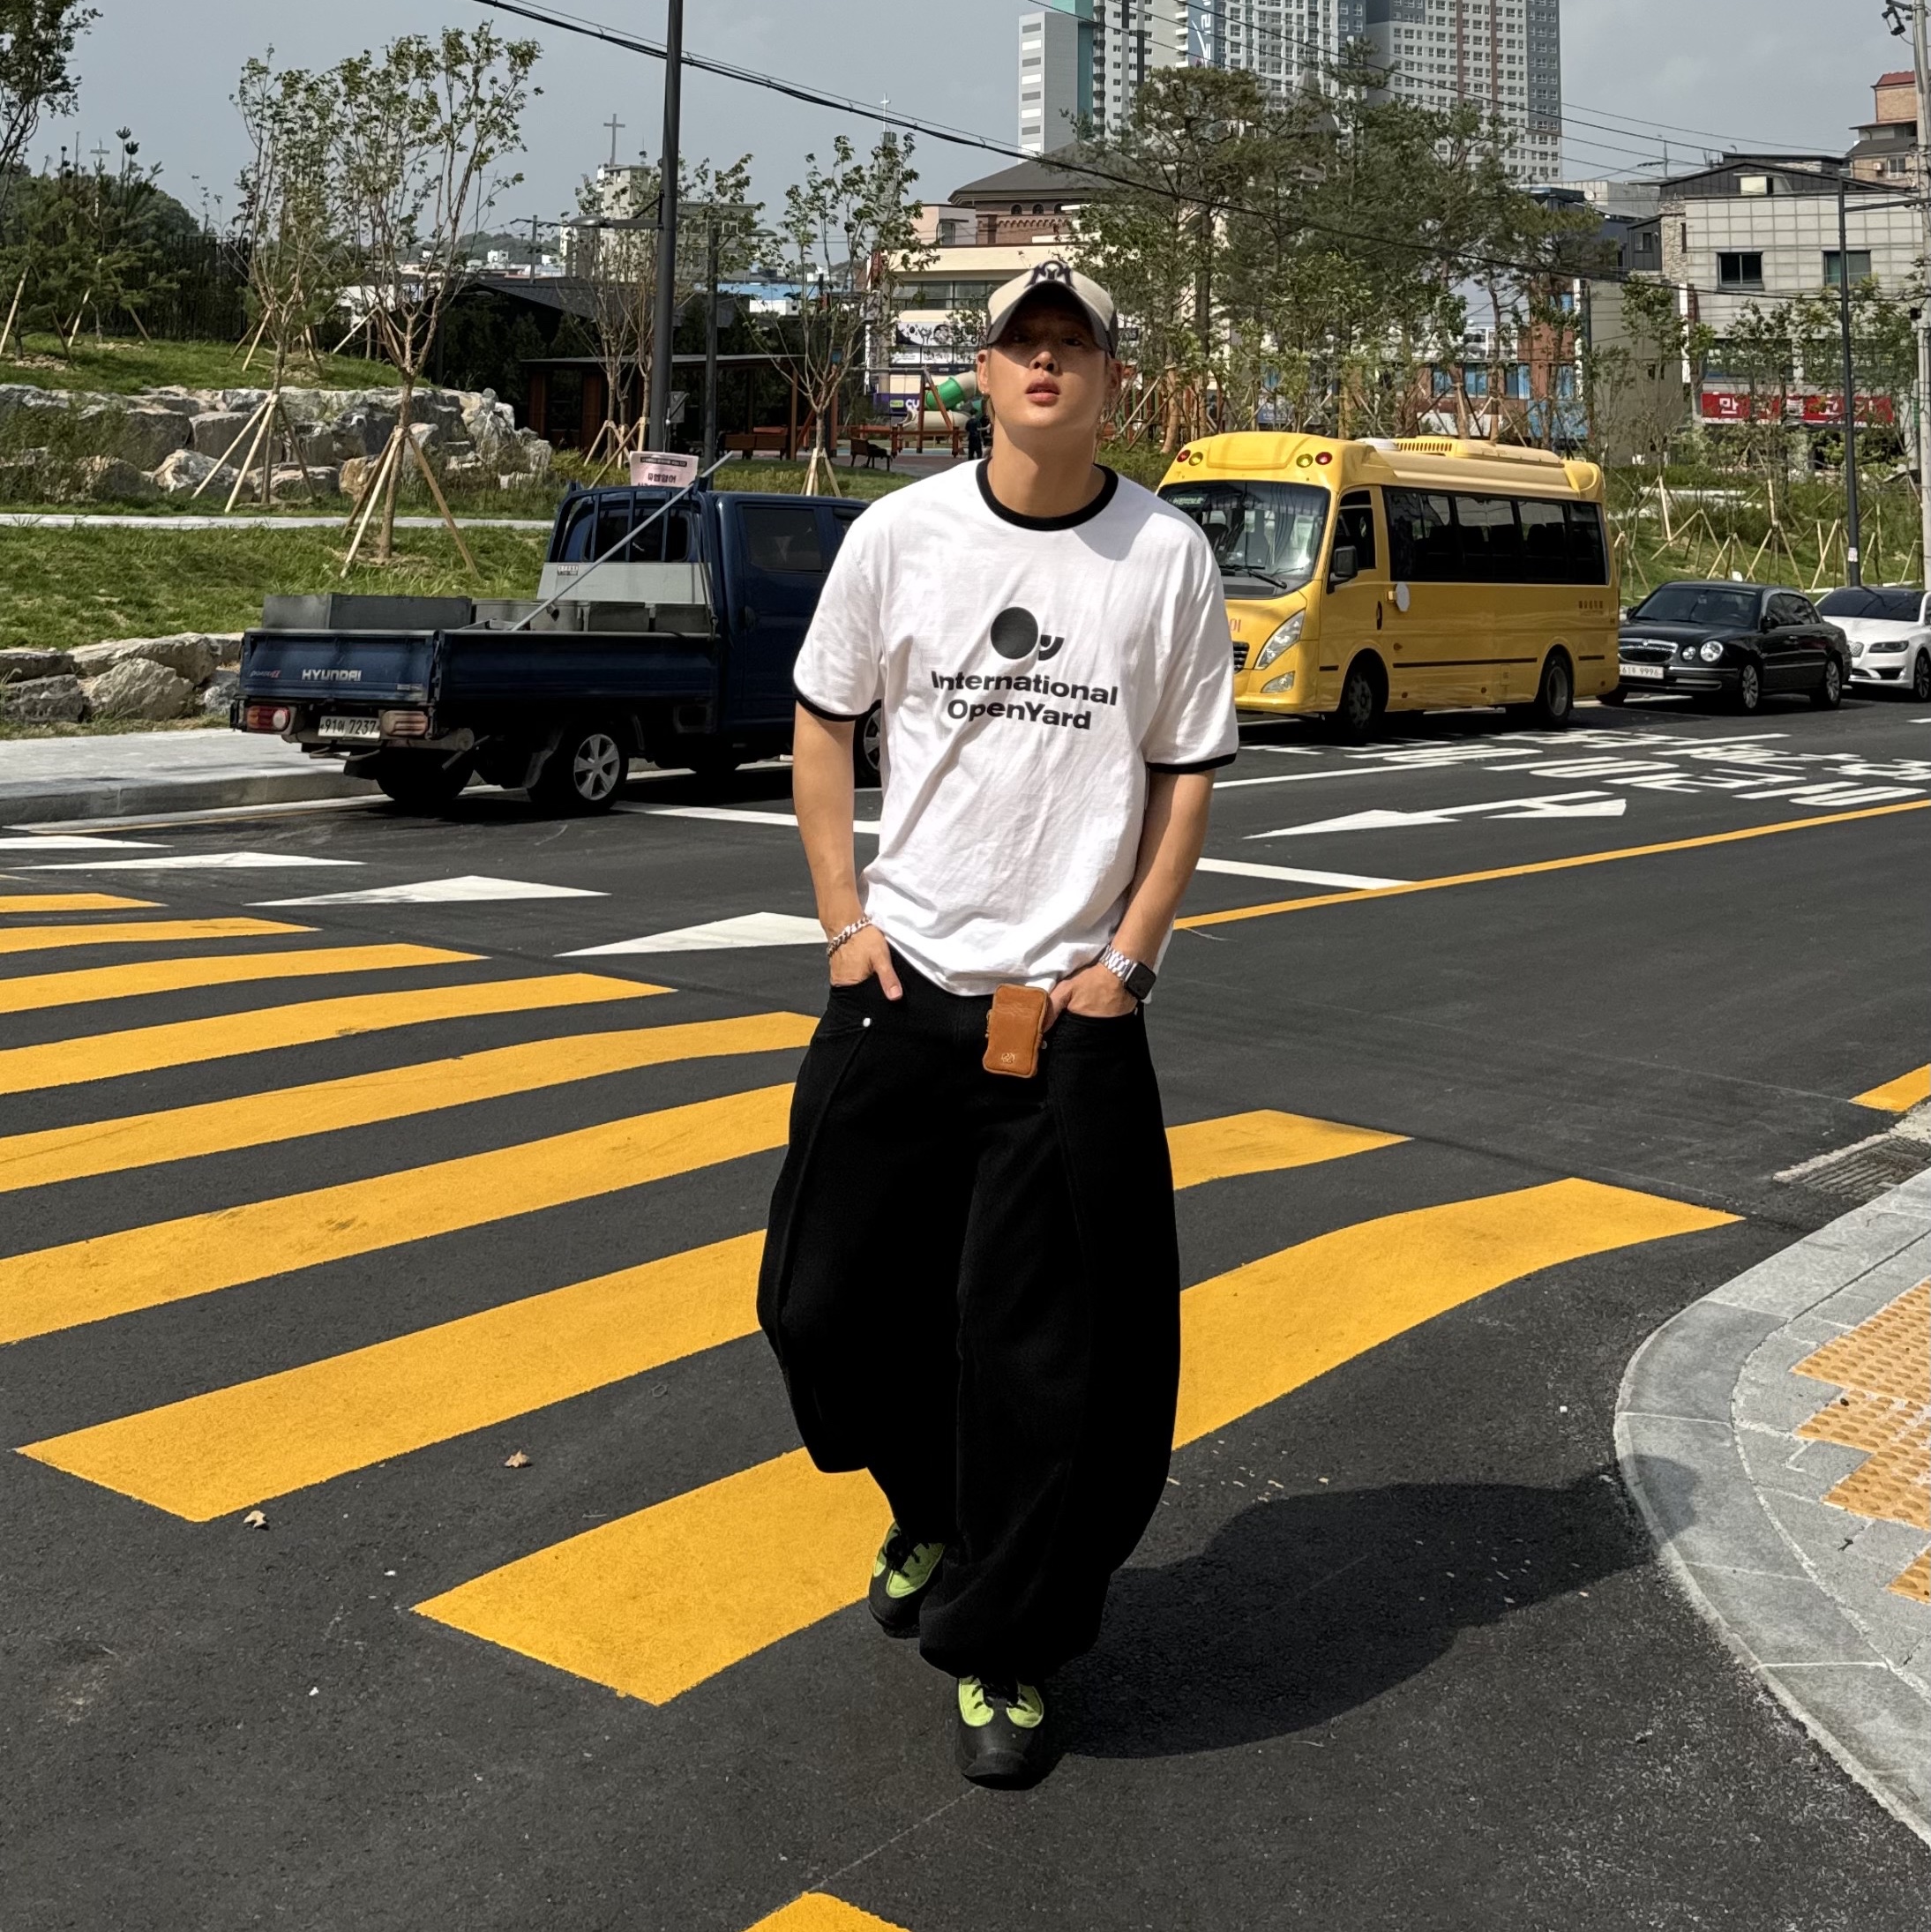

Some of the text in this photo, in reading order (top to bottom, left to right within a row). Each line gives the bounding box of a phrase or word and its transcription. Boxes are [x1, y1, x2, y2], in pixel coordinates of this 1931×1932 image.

[905, 399, 920, 409] CU
[302, 669, 363, 682] HYUNDAI
[931, 670, 1119, 706] International
[947, 699, 1092, 730] OpenYard
[349, 719, 377, 736] 7237
